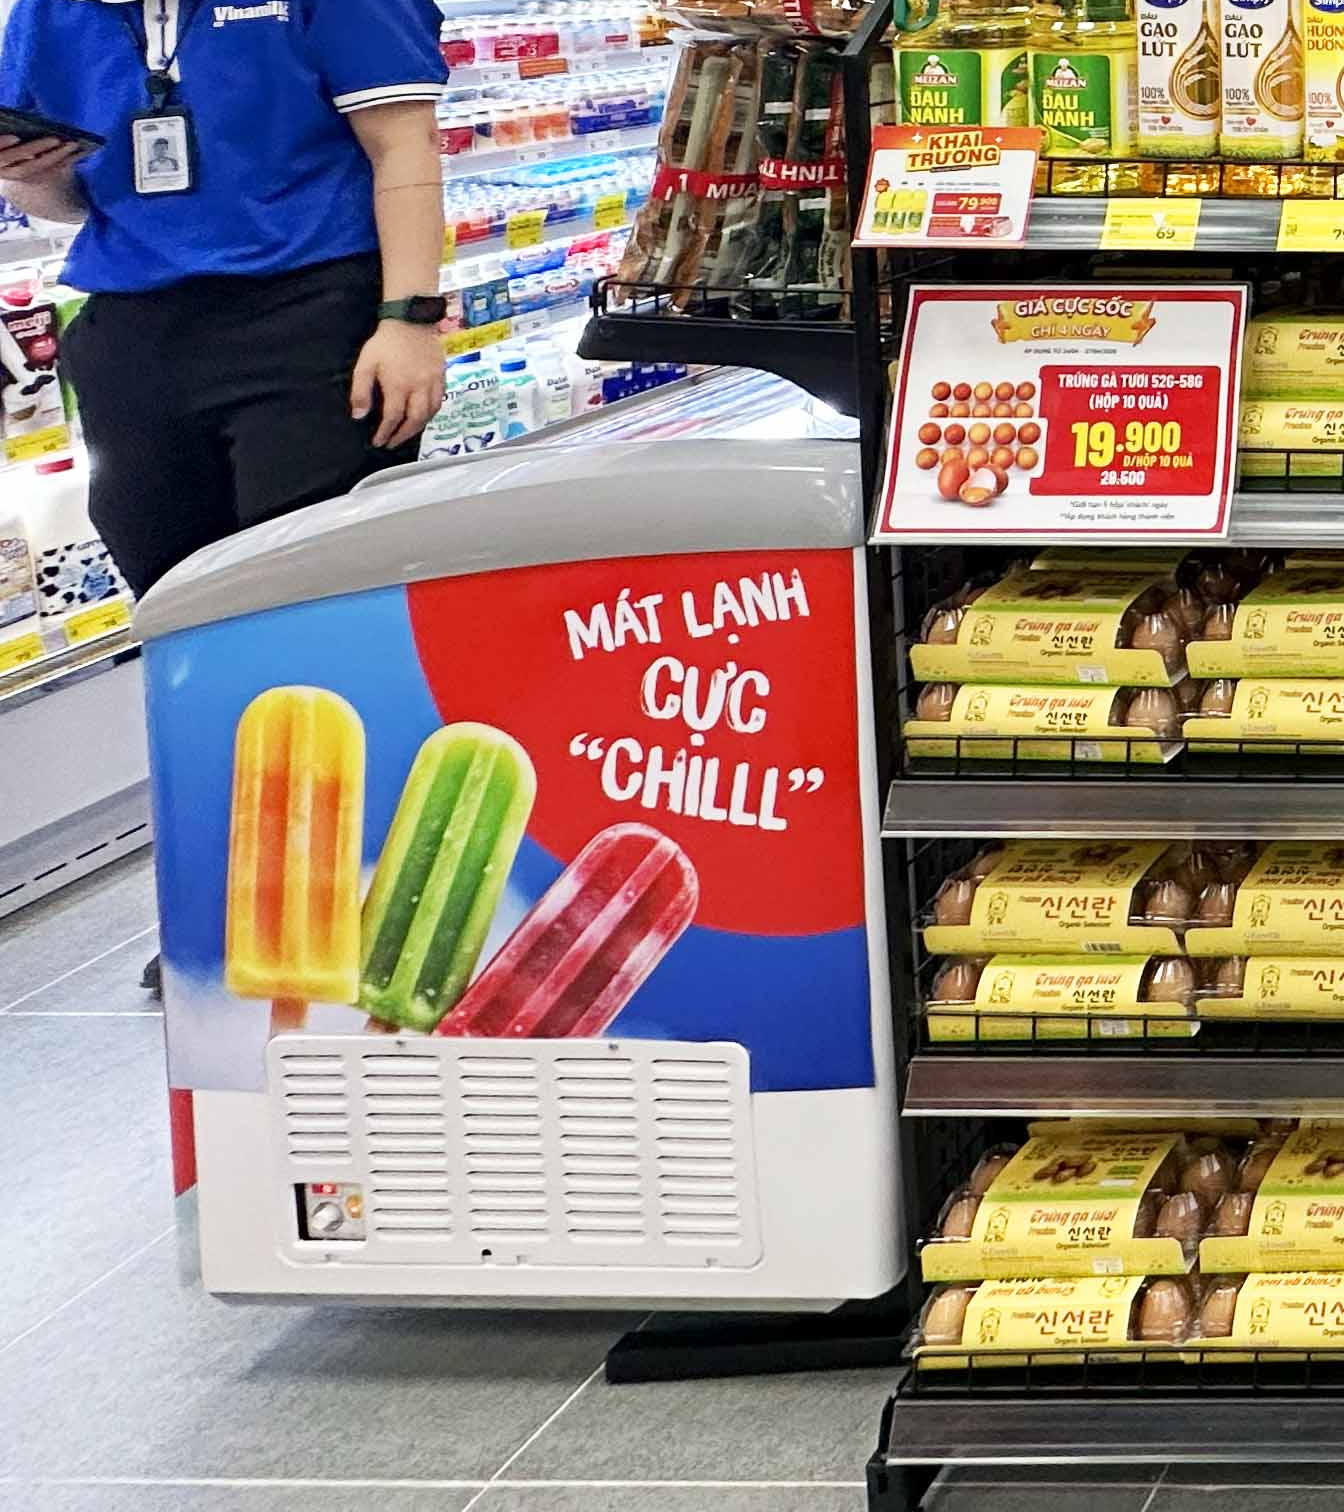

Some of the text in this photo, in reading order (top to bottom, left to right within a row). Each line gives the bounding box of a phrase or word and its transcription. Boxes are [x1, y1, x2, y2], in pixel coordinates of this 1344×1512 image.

[213, 0, 289, 23] Vinamilk
[914, 74, 957, 86] MEIZAN
[929, 134, 980, 150] KHAI
[908, 148, 997, 168] TRƯƠNG
[1156, 227, 1175, 240] 69
[1015, 296, 1132, 318] GIÁ CỰC SỐC
[1059, 326, 1068, 337] 4
[1058, 372, 1203, 388] TRỨNG GÀ TƯƠI 52G-58G
[1089, 393, 1119, 411] (HỘP
[1122, 394, 1136, 409] 10
[1072, 422, 1181, 467] 19.900
[563, 568, 810, 660] MÁT LẠNH
[641, 656, 770, 746] CỰC
[1040, 895, 1117, 919] 신선란
[1034, 1310, 1114, 1334] 신선란
